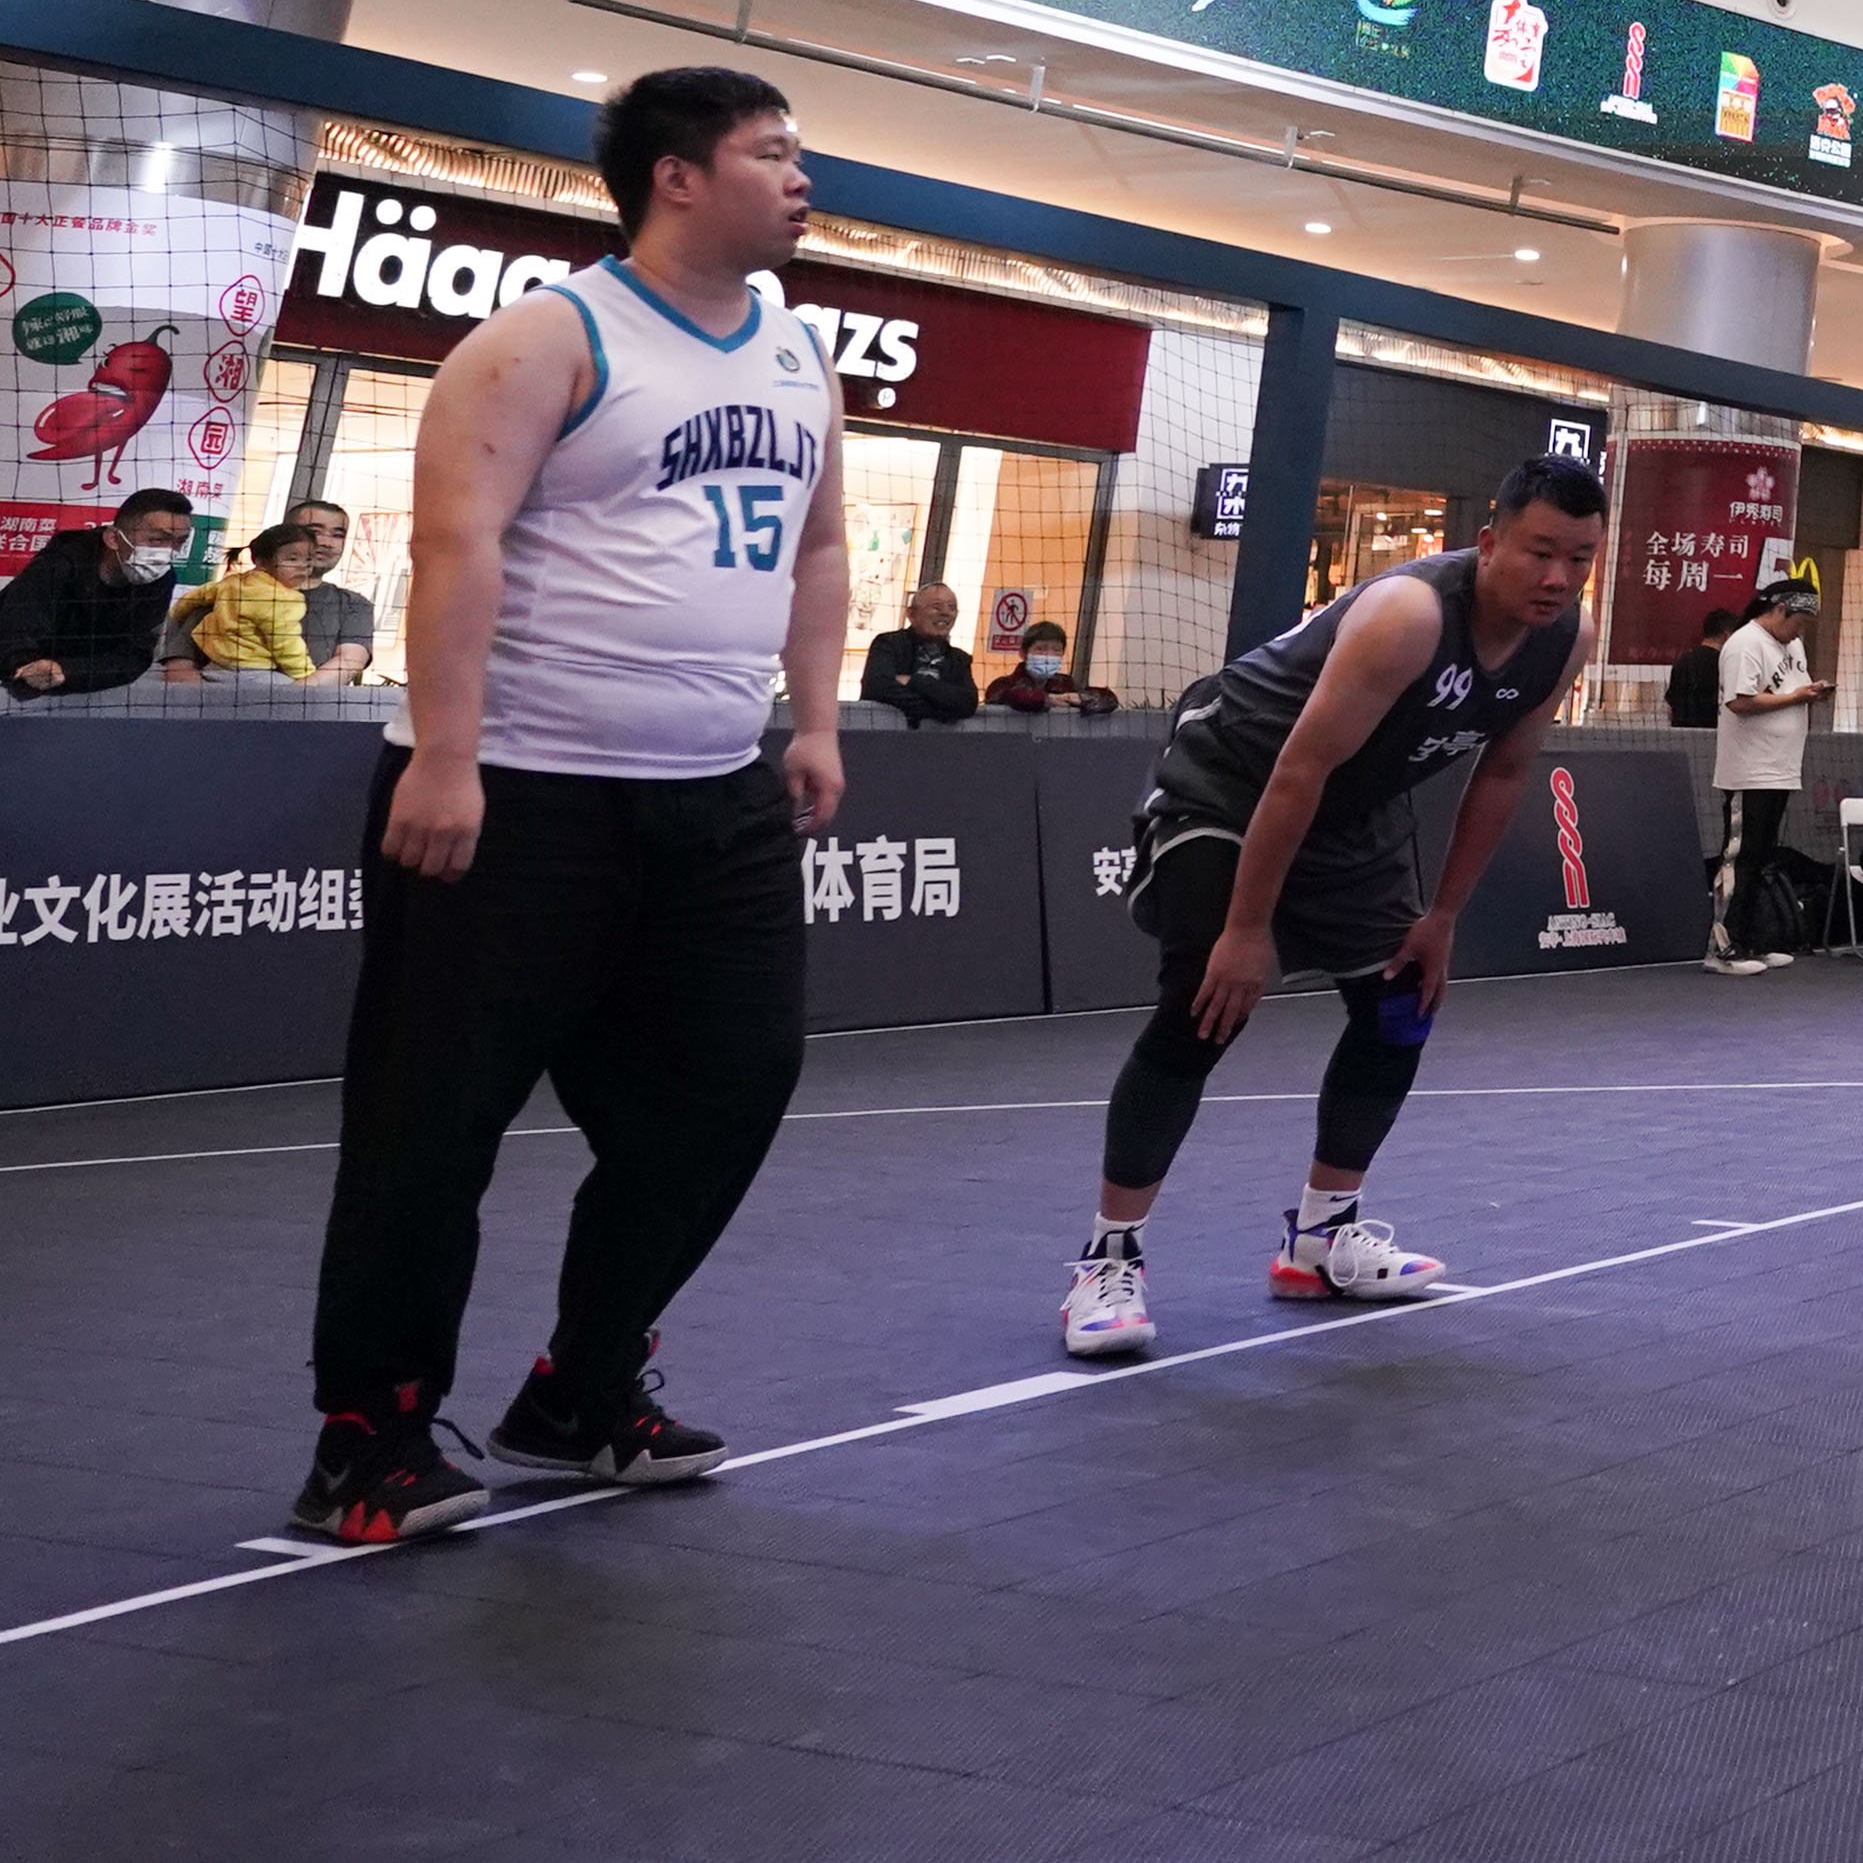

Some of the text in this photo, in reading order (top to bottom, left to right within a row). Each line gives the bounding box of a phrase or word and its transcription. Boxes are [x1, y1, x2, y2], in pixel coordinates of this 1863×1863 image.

[701, 484, 784, 572] 15
[1646, 531, 1750, 559] 全场寿司
[1644, 559, 1744, 592] 每周一
[1427, 662, 1474, 711] 99
[800, 833, 961, 924] 体育局
